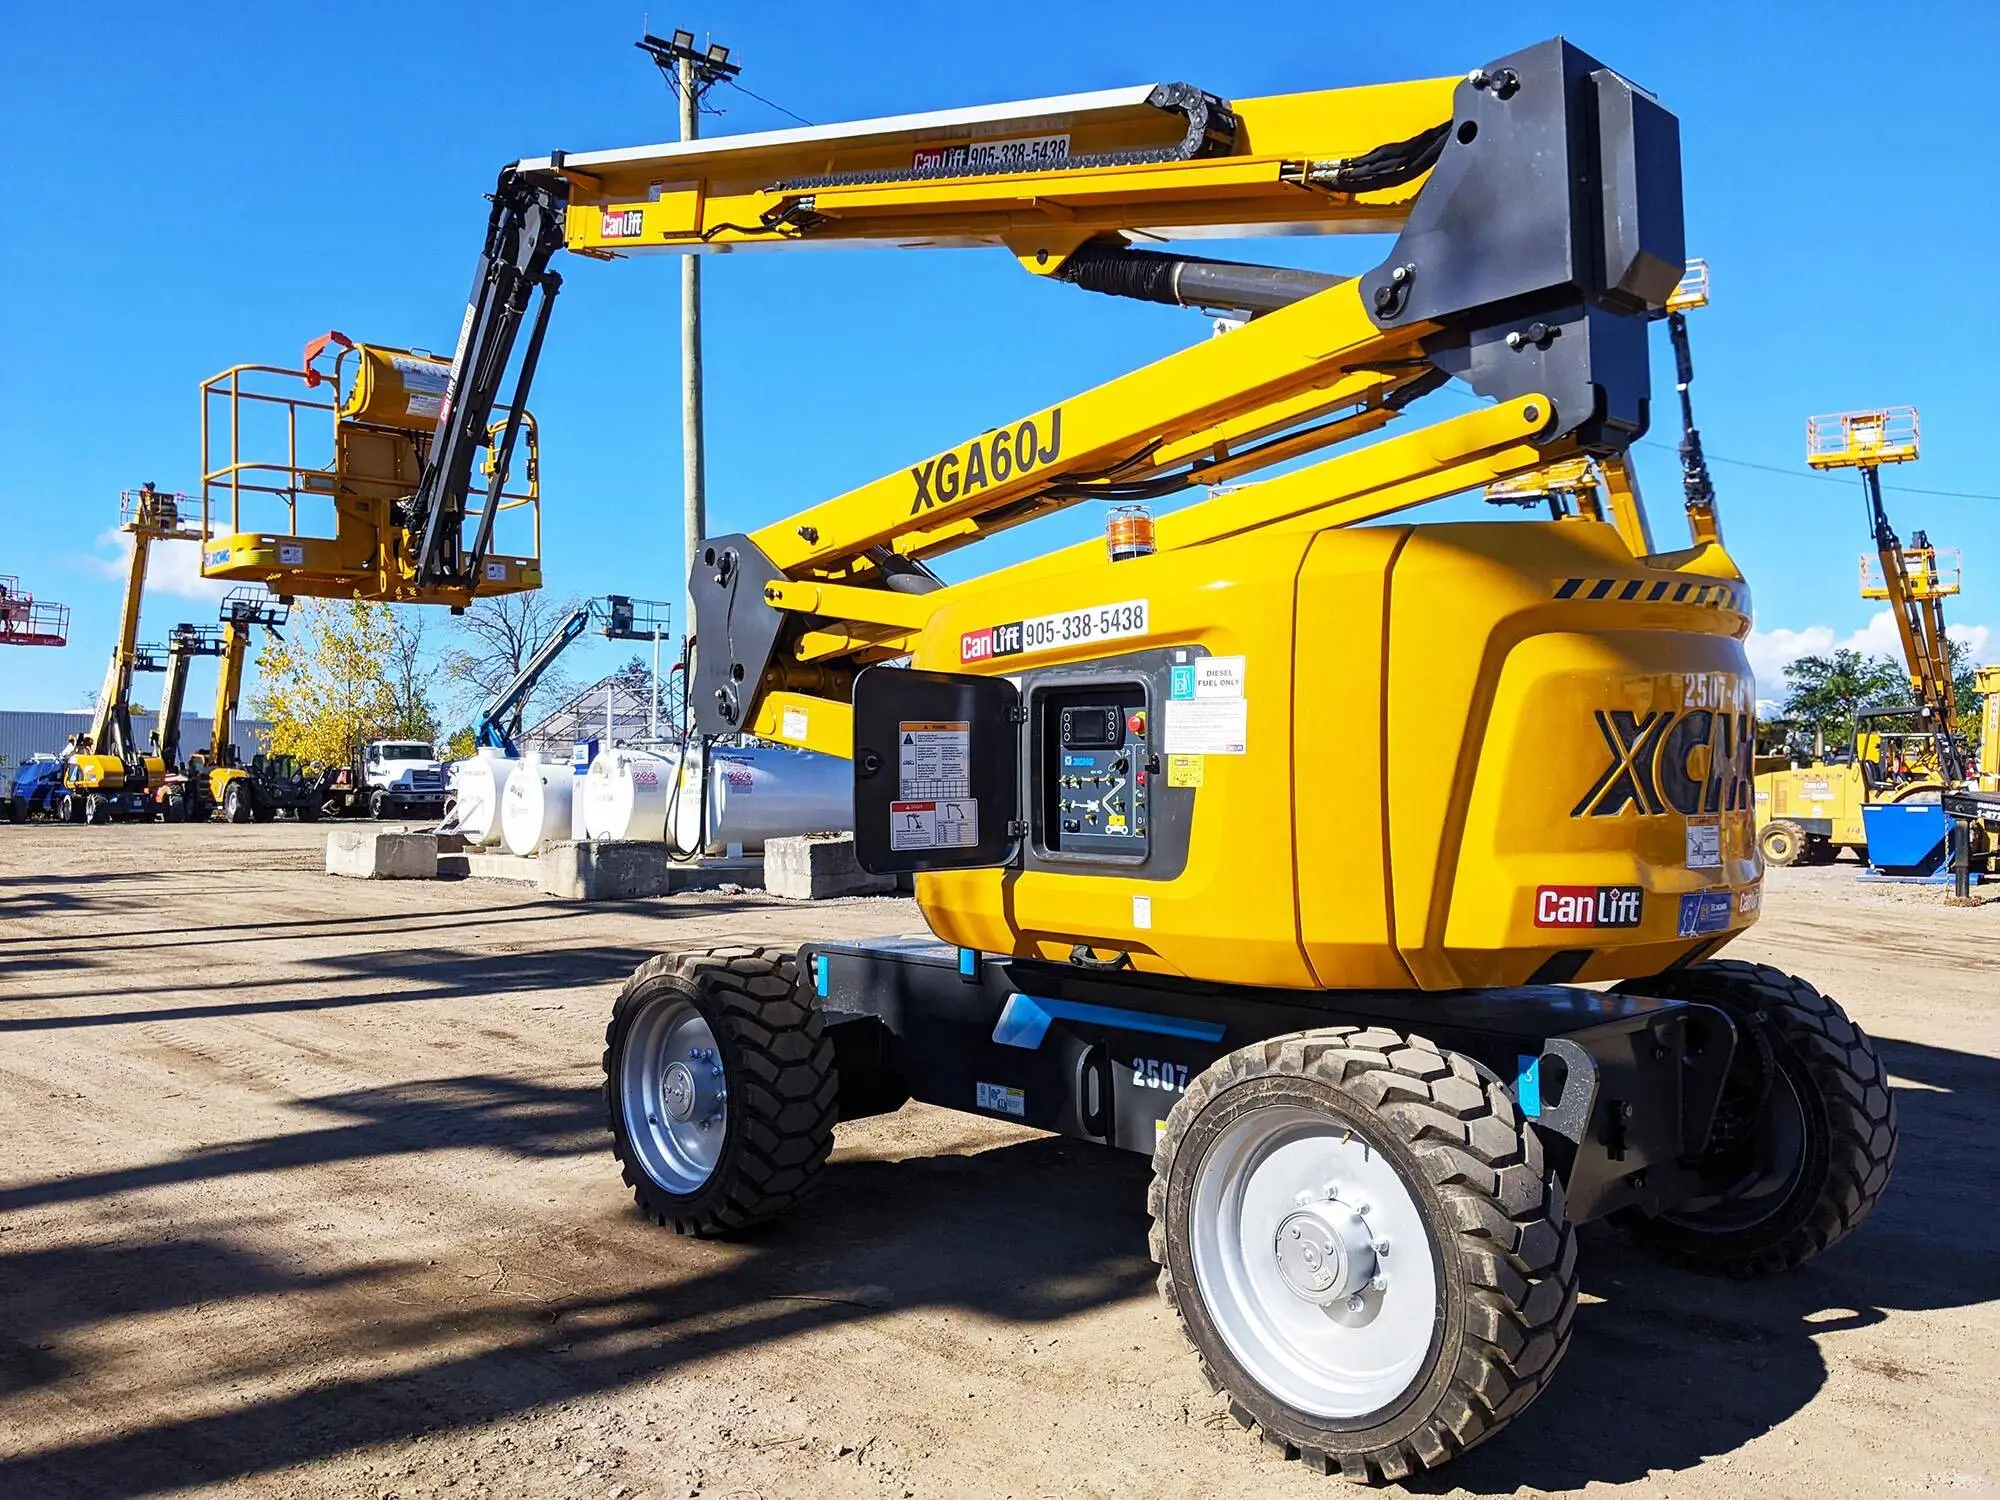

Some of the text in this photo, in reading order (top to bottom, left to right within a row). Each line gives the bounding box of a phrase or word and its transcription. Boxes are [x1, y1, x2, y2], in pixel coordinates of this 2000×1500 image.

[968, 139, 1067, 165] 905-338-5438
[603, 211, 642, 235] CanLift
[910, 408, 1061, 515] XGA60J
[962, 604, 1144, 660] CanLift 905-338-5438
[1197, 679, 1218, 687] FUEL
[1206, 669, 1233, 677] DIESEL
[1570, 709, 1756, 817] XCM
[1538, 888, 1639, 923] CanLift
[1132, 1057, 1188, 1094] 2507
